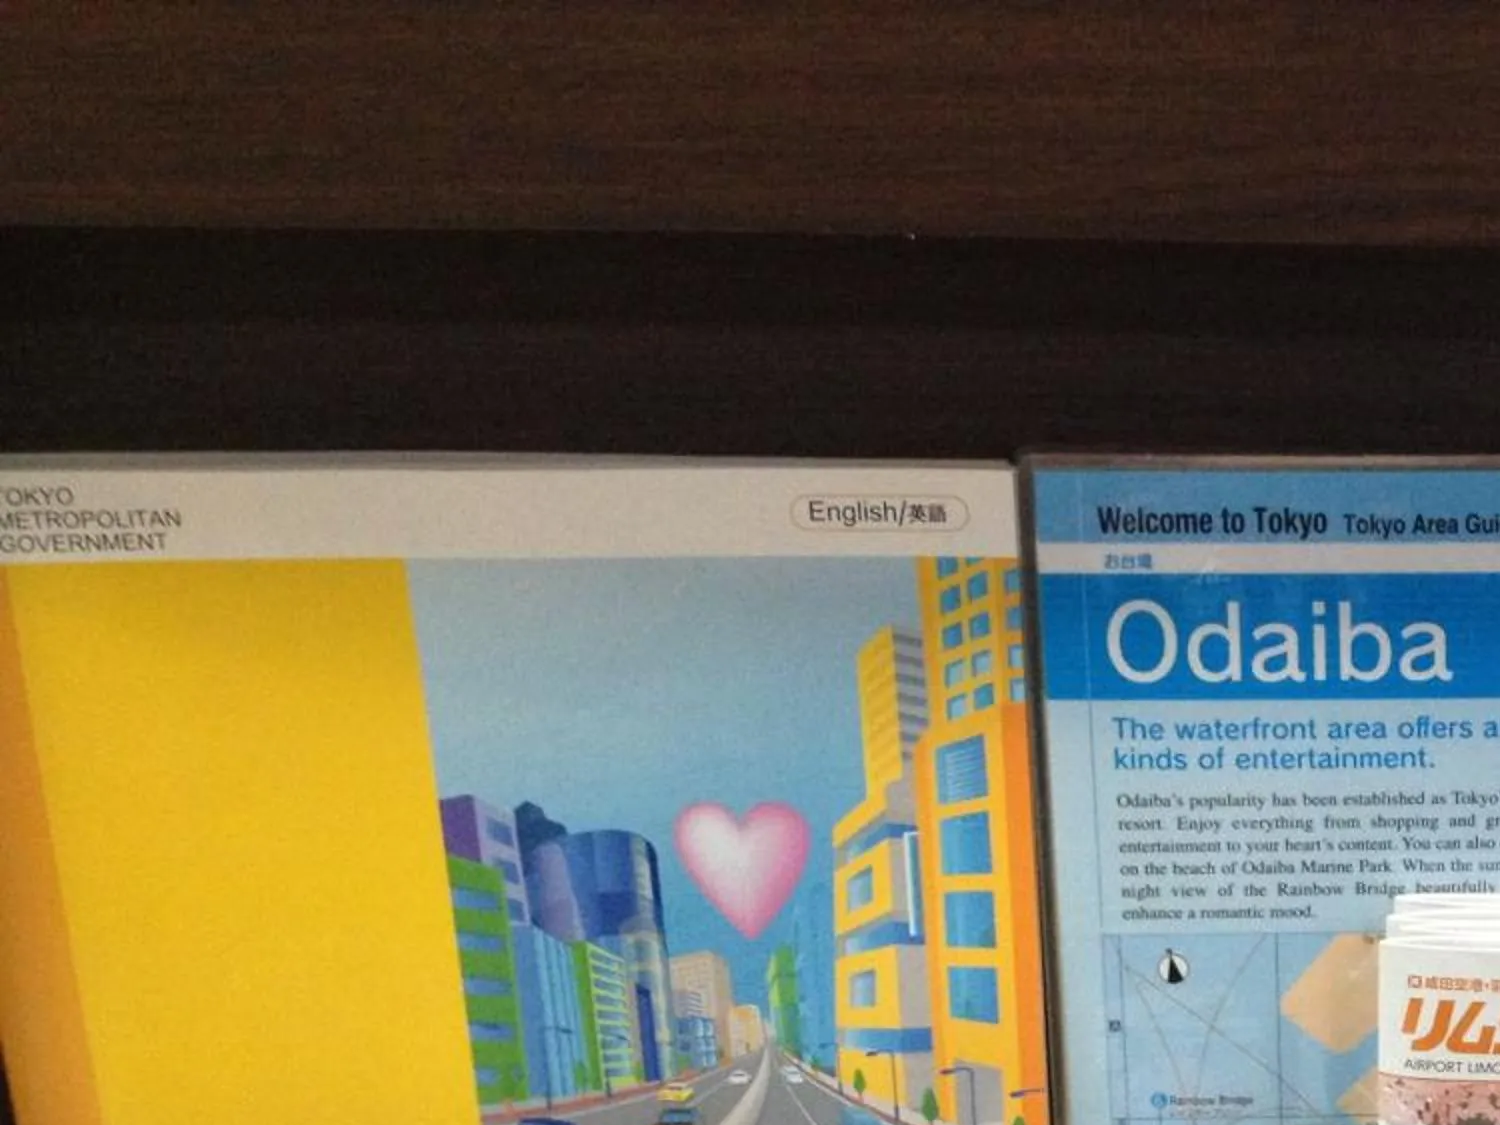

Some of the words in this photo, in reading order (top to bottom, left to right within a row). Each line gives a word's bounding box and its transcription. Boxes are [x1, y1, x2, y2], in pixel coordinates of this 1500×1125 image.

[1097, 506, 1212, 534] Welcome
[1222, 507, 1245, 534] to
[1253, 506, 1328, 540] Tokyo
[1343, 513, 1406, 539] Tokyo
[1412, 513, 1459, 535] Area
[0, 532, 167, 552] GOVERNMENT
[1106, 599, 1454, 683] Odaiba
[1112, 717, 1165, 740] The
[1175, 717, 1317, 740] waterfront
[1328, 721, 1387, 740] area
[1398, 715, 1473, 740] offers
[1114, 747, 1188, 770] kinds
[1197, 747, 1224, 770] of
[1235, 747, 1435, 770] entertainment.
[1189, 793, 1265, 811] popularity
[1272, 793, 1297, 807] has
[1303, 793, 1337, 806] been
[1343, 792, 1425, 806] established
[1432, 796, 1446, 805] as
[1177, 816, 1222, 833] Enjoy
[1231, 815, 1314, 832] everything
[1324, 815, 1361, 829] from
[1371, 813, 1439, 831] shopping
[1449, 814, 1475, 827] and
[1119, 841, 1221, 853] entertainment
[1227, 841, 1241, 852] to
[1246, 843, 1279, 855] your
[1285, 839, 1334, 852] heart's
[1403, 837, 1431, 850] You
[1435, 840, 1461, 849] can
[1466, 836, 1495, 849] also
[1120, 864, 1138, 875] on
[1144, 862, 1167, 875] the
[1172, 861, 1216, 875] beach
[1221, 861, 1238, 875] of
[1241, 860, 1295, 874] Odaiba
[1301, 860, 1353, 874] Marine
[1403, 858, 1445, 871] When
[1451, 858, 1473, 871] the
[1121, 884, 1160, 901] night
[1172, 884, 1206, 897] view
[1217, 882, 1234, 896] of
[1244, 883, 1267, 896] the
[1277, 882, 1343, 896] Rainbow
[1355, 881, 1405, 898] Bridge
[1122, 907, 1183, 920] enhance
[1187, 910, 1196, 919] a
[1200, 906, 1264, 919] romantic
[1404, 1059, 1463, 1073] AIRPORT
